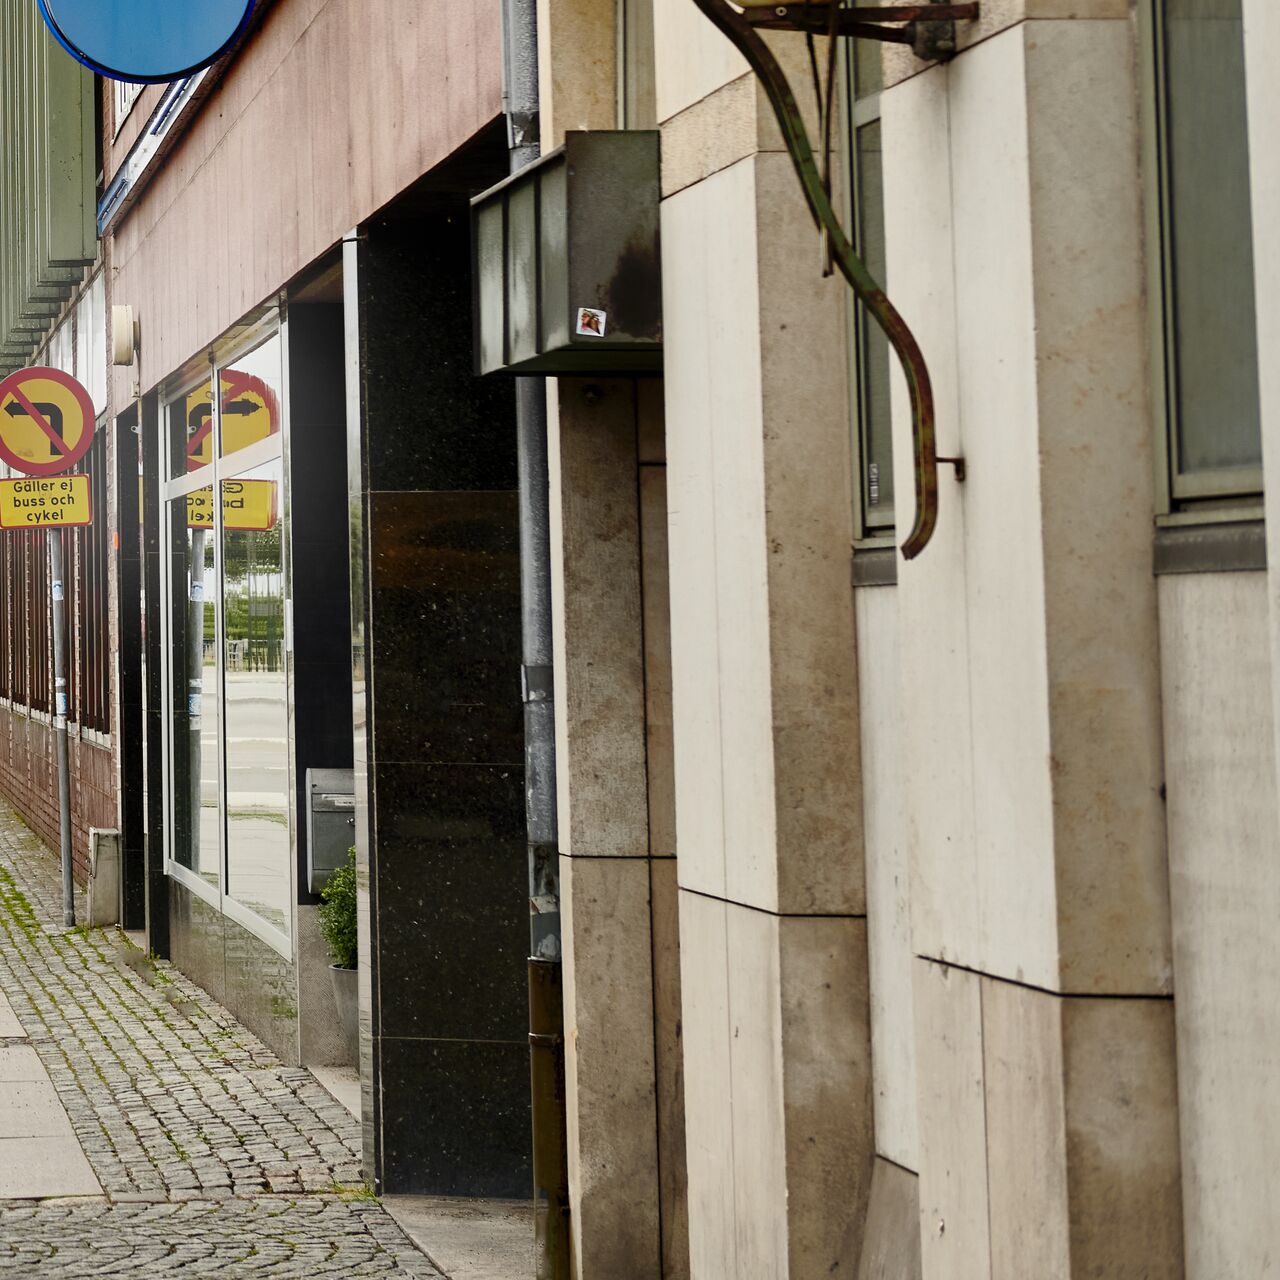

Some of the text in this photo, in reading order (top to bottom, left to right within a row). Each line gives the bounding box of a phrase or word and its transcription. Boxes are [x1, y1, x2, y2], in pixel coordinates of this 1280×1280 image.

[13, 478, 74, 493] Gäller ej
[13, 493, 75, 508] buss och
[26, 508, 64, 524] cykel
